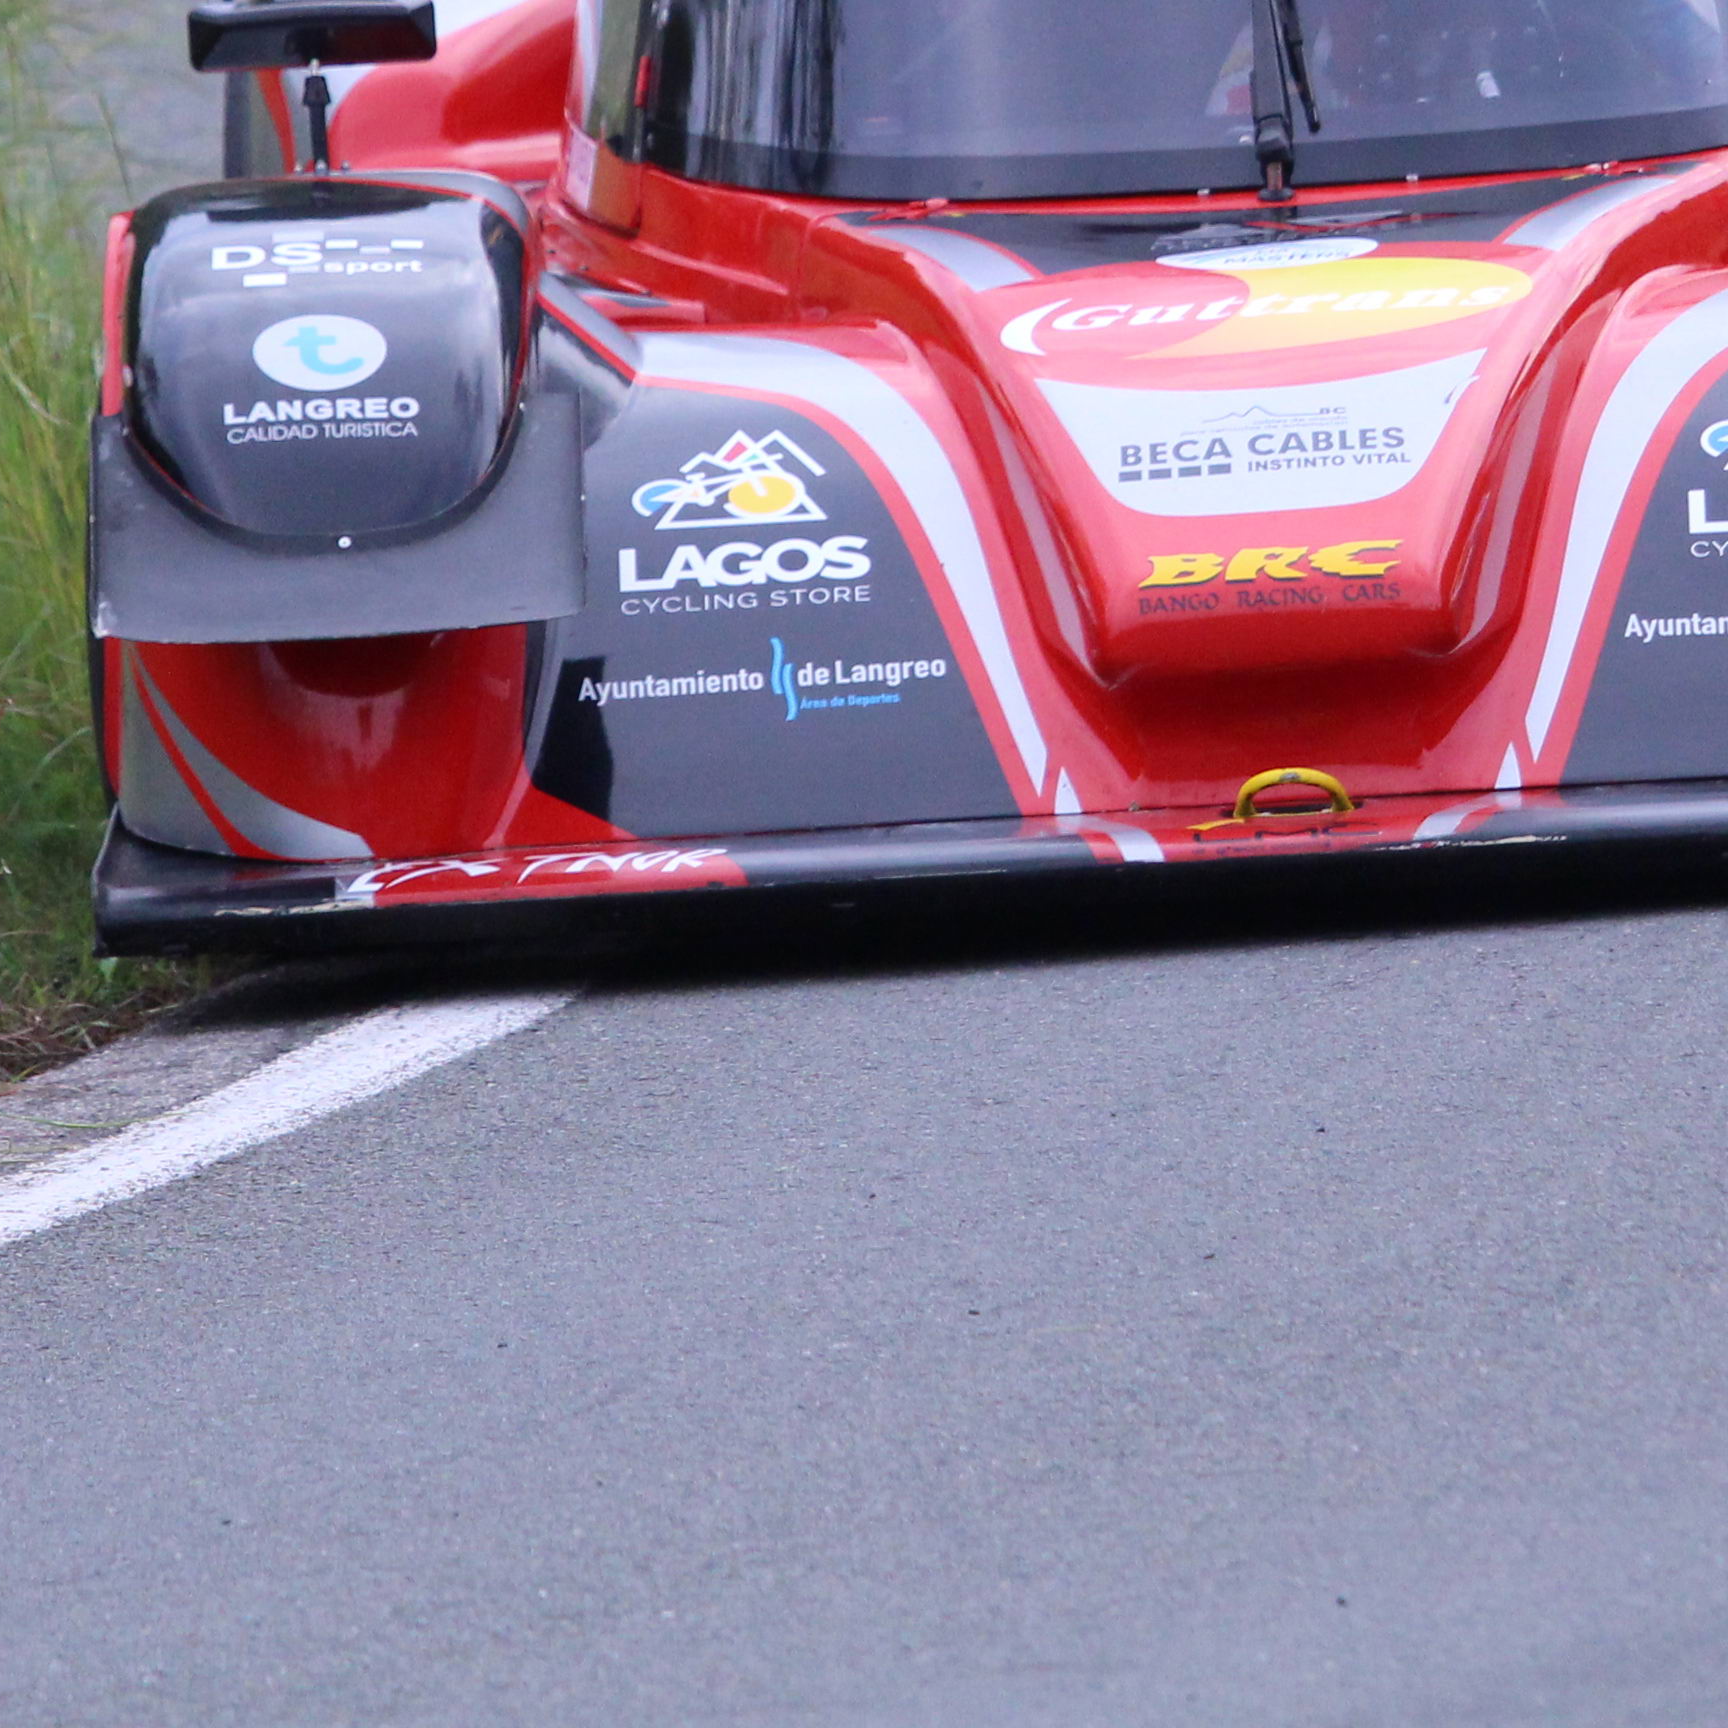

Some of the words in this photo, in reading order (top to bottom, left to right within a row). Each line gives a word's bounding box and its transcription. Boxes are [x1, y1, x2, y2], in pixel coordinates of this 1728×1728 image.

[211, 242, 323, 271] DS
[323, 259, 423, 276] sport
[1051, 284, 1510, 331] Guttrans
[223, 396, 420, 425] LANGREO
[226, 423, 317, 445] CALIDAD
[1120, 436, 1233, 468] BECA
[1247, 426, 1406, 457] CABLES
[1247, 454, 1346, 473] INSTINTO
[1352, 451, 1412, 466] VITAL
[618, 534, 872, 593] LAGOS
[1137, 538, 1405, 590] BRC
[620, 592, 759, 616] CYCLING
[769, 584, 872, 608] STORE
[1138, 591, 1221, 616] BANGO
[1236, 586, 1324, 608] RACING
[1342, 582, 1402, 603] CARS
[577, 669, 764, 707] Ayuntamiento
[797, 662, 831, 688] de
[834, 657, 946, 688] Langreo
[830, 695, 845, 707] de
[847, 693, 901, 707] Deportes
